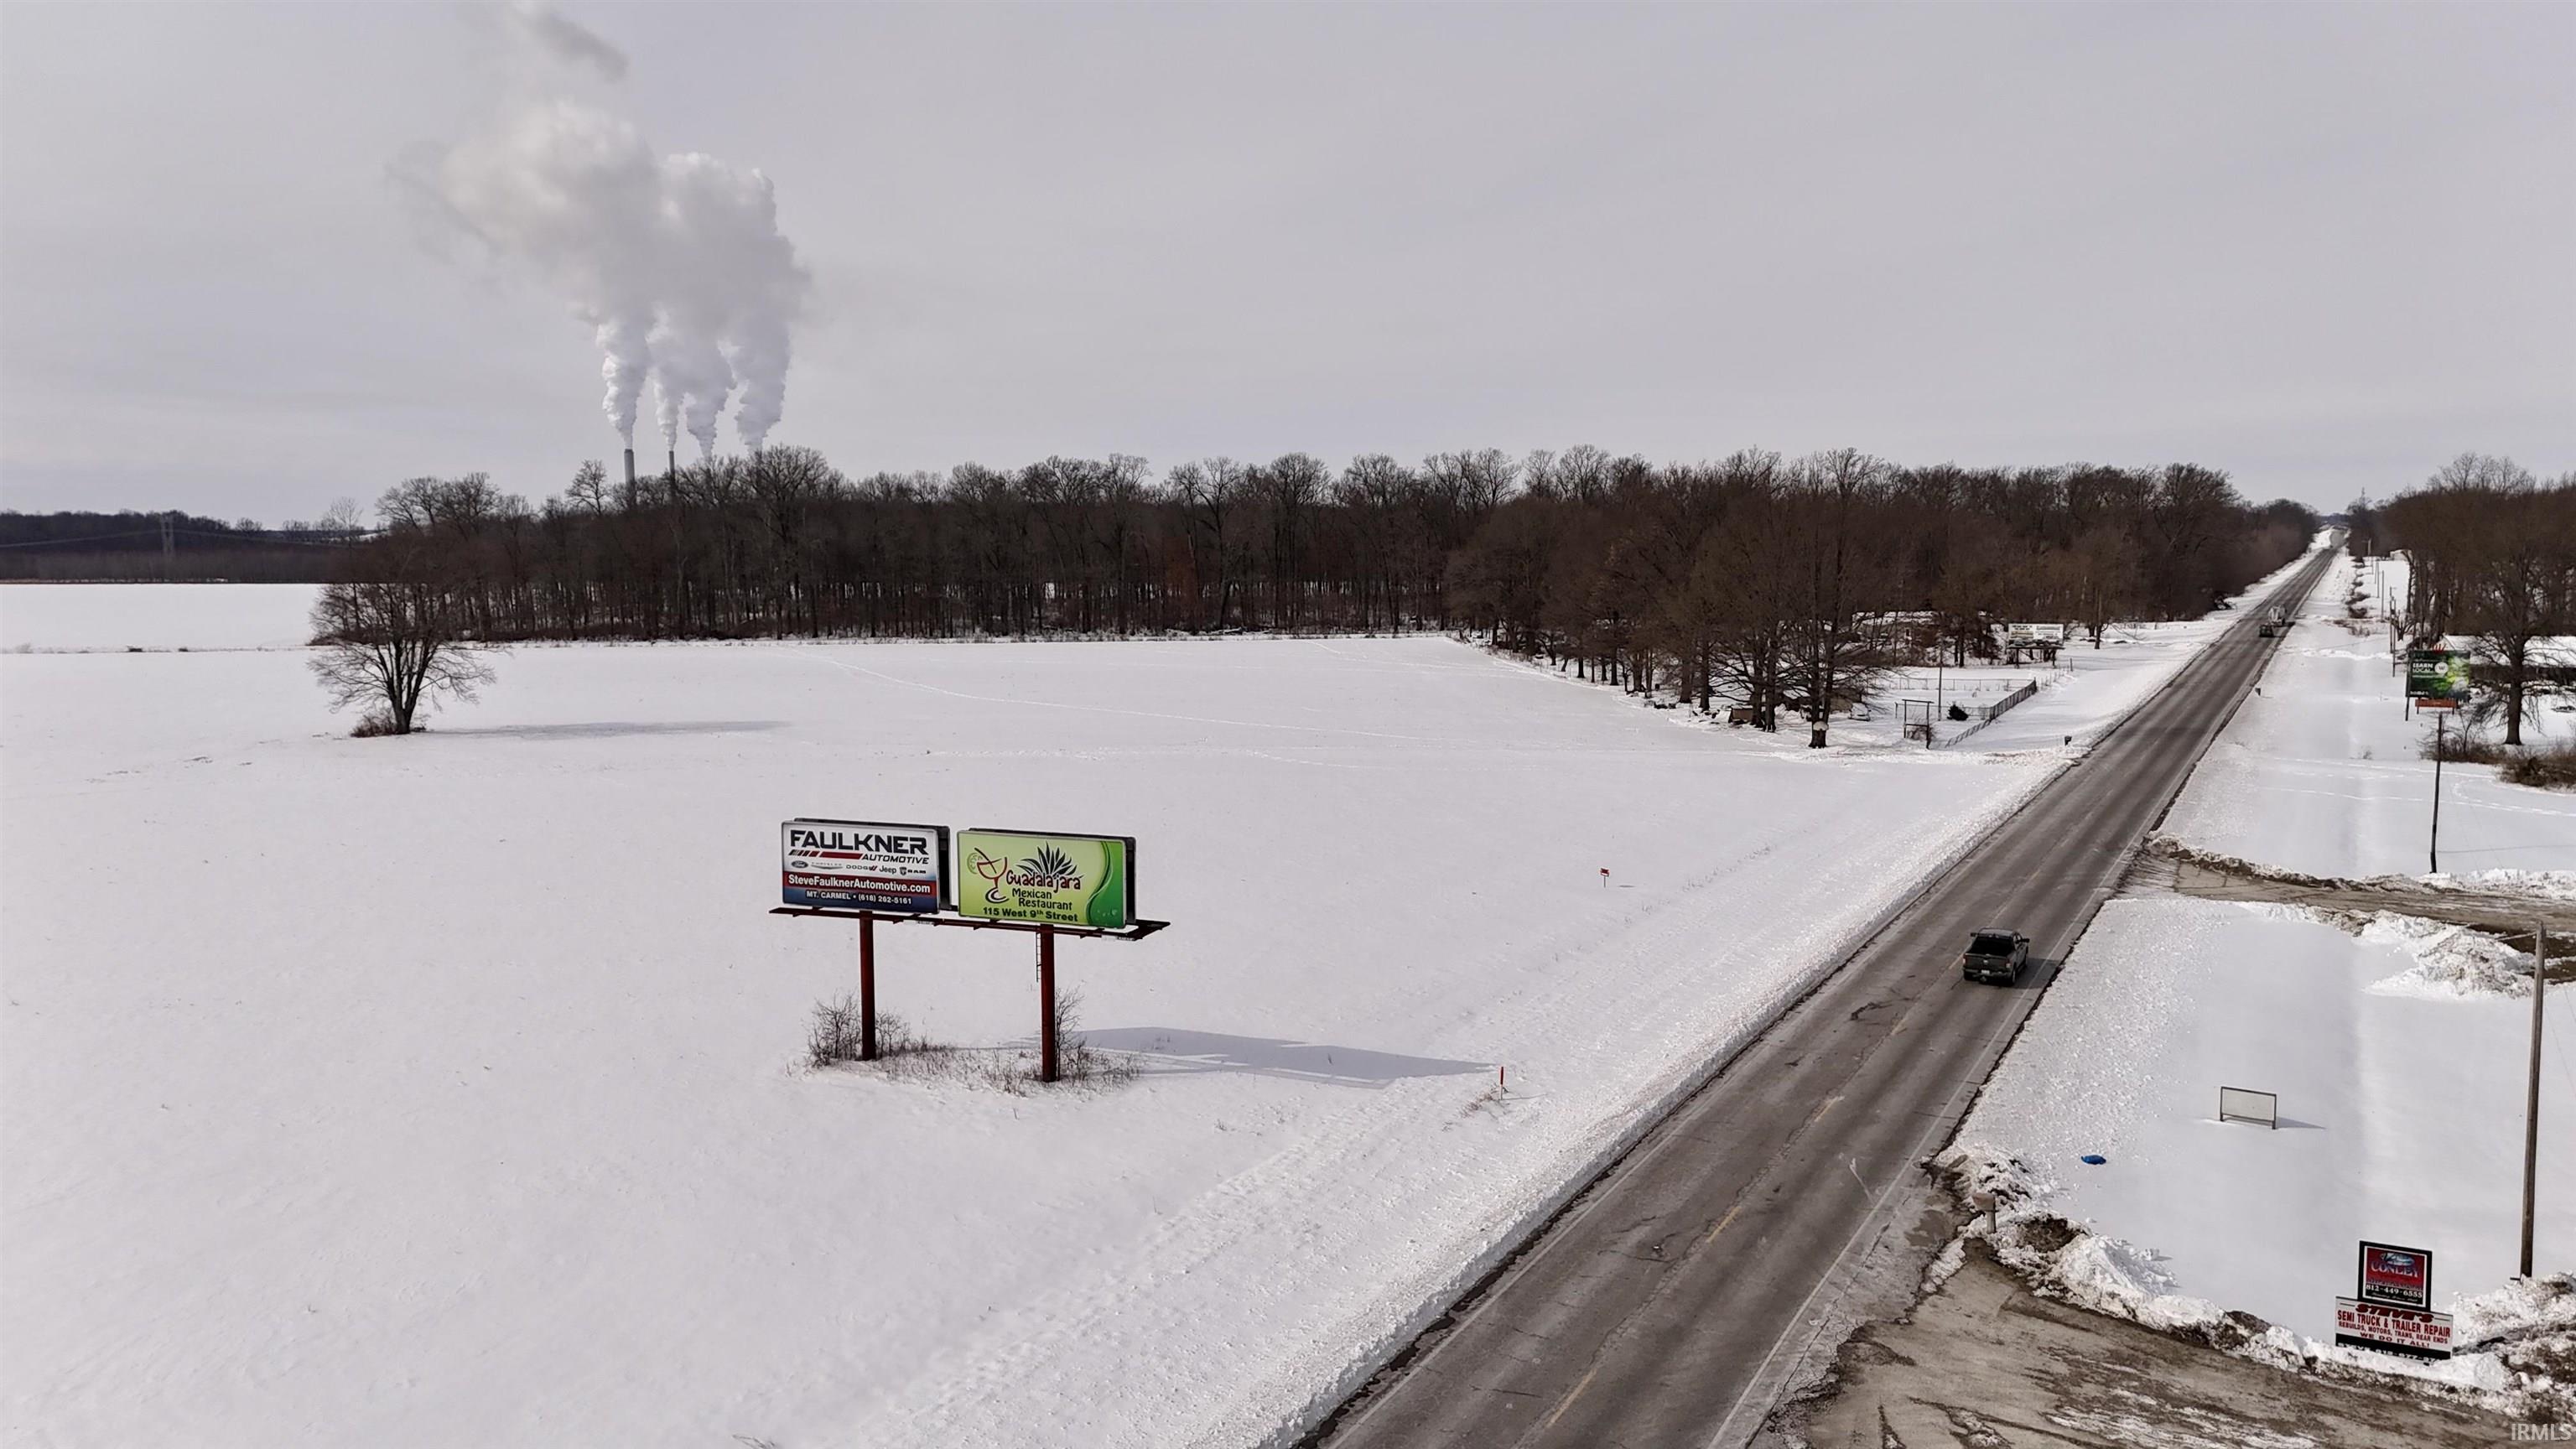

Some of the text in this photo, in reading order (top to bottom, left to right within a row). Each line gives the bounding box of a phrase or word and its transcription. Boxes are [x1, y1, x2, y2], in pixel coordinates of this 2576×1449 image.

[790, 829, 929, 855] FAULKNER
[861, 854, 930, 865] AUTOMOTIVE
[879, 865, 897, 874] Jeep
[788, 874, 931, 893] SteveFaulknerAutomotive.com
[1006, 870, 1081, 894] Guadalajara
[820, 891, 851, 900] CARMEL
[858, 894, 876, 902] (618)
[1012, 888, 1052, 899] Mexican
[1018, 897, 1072, 911] Restaurant
[983, 906, 1078, 922] 115 West 9th Street
[2337, 1309, 2450, 1338] SEMI TRUCK & TRAILER REPAIR
